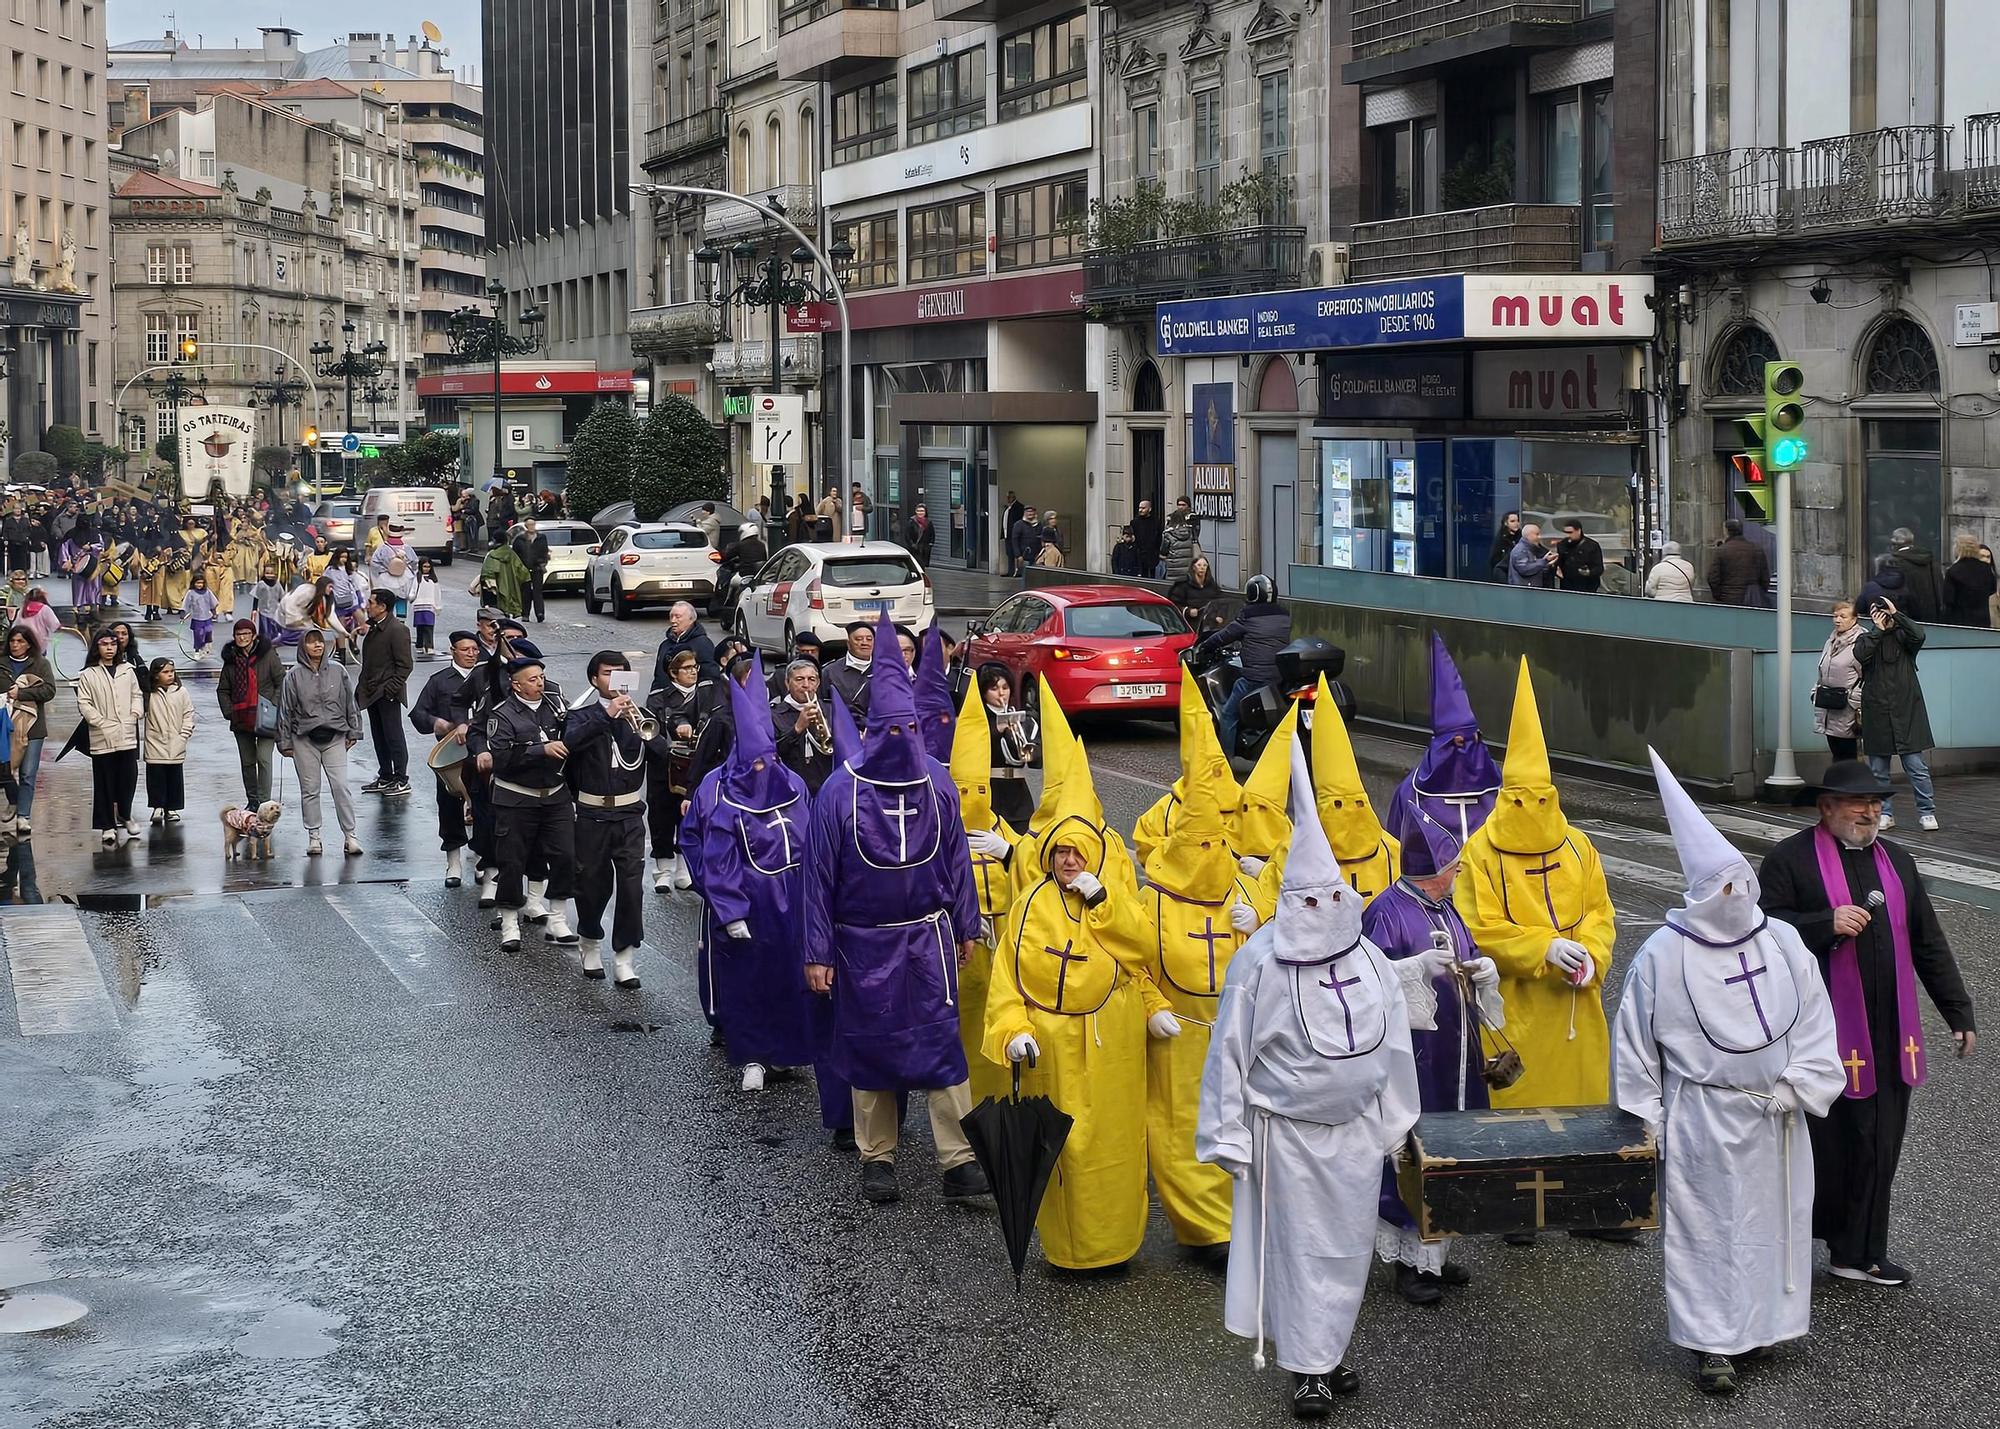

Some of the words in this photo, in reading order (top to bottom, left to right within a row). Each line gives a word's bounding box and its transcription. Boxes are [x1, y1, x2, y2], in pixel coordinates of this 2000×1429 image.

[924, 289, 965, 318] GENERALI
[1317, 298, 1363, 317] EXPERTOS
[1364, 291, 1435, 314] INMOBILIARIOS
[1492, 284, 1624, 326] muat
[1257, 310, 1279, 323] INDIGO
[1380, 315, 1411, 333] DESDE
[1412, 313, 1435, 331] 1906
[1173, 320, 1216, 338] COLDWELL
[1217, 318, 1249, 336] BANKER
[1257, 326, 1274, 338] REAL
[1274, 323, 1296, 337] ESTATE
[1342, 380, 1383, 394] COLDWELL
[1384, 379, 1417, 394] BANKER
[1508, 354, 1598, 410] muat
[183, 420, 197, 432] OS
[198, 413, 252, 434] TARTEIRAS
[1194, 466, 1230, 490] ALQUILA
